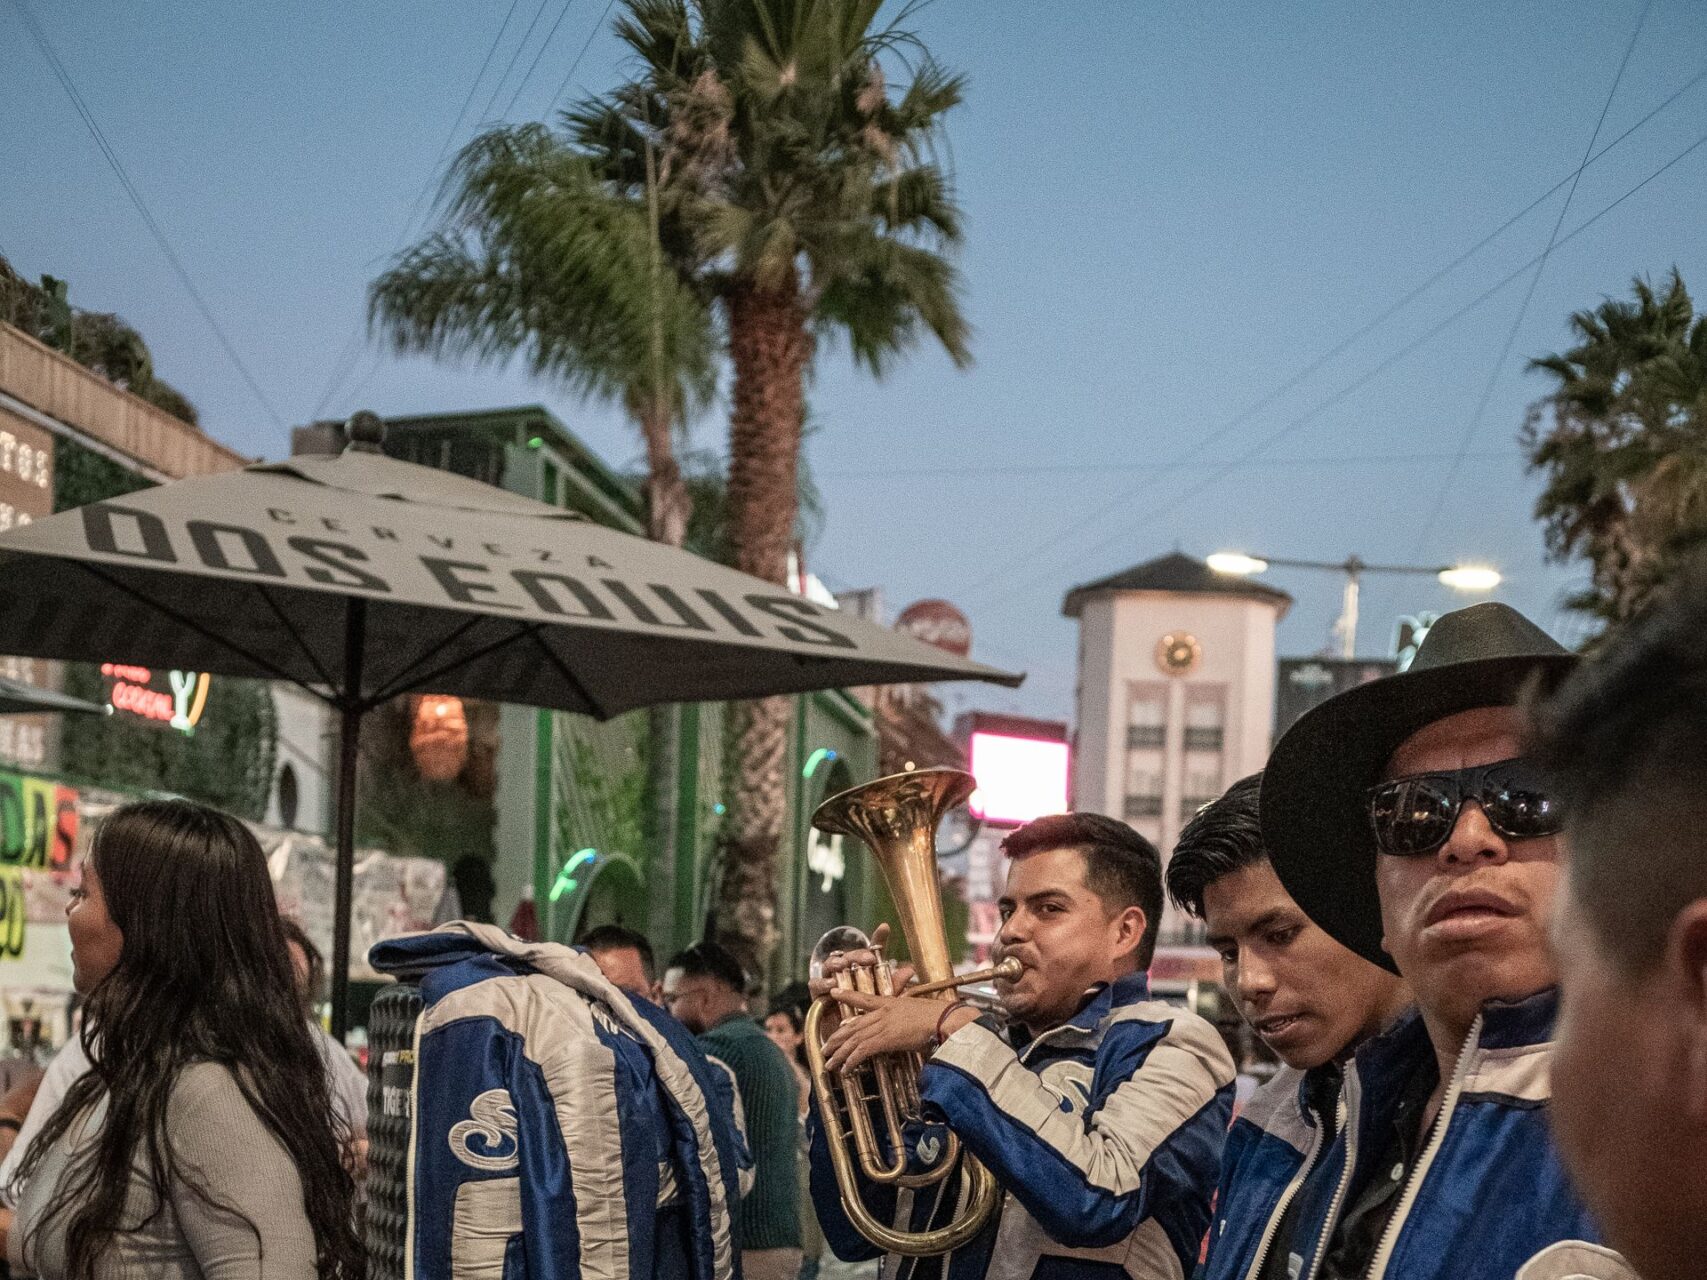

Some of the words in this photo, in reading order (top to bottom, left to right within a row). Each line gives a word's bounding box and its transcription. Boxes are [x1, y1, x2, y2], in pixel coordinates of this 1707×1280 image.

[81, 501, 391, 592] DOS
[418, 555, 858, 649] EQUIS
[267, 506, 614, 570] CERVEZA
